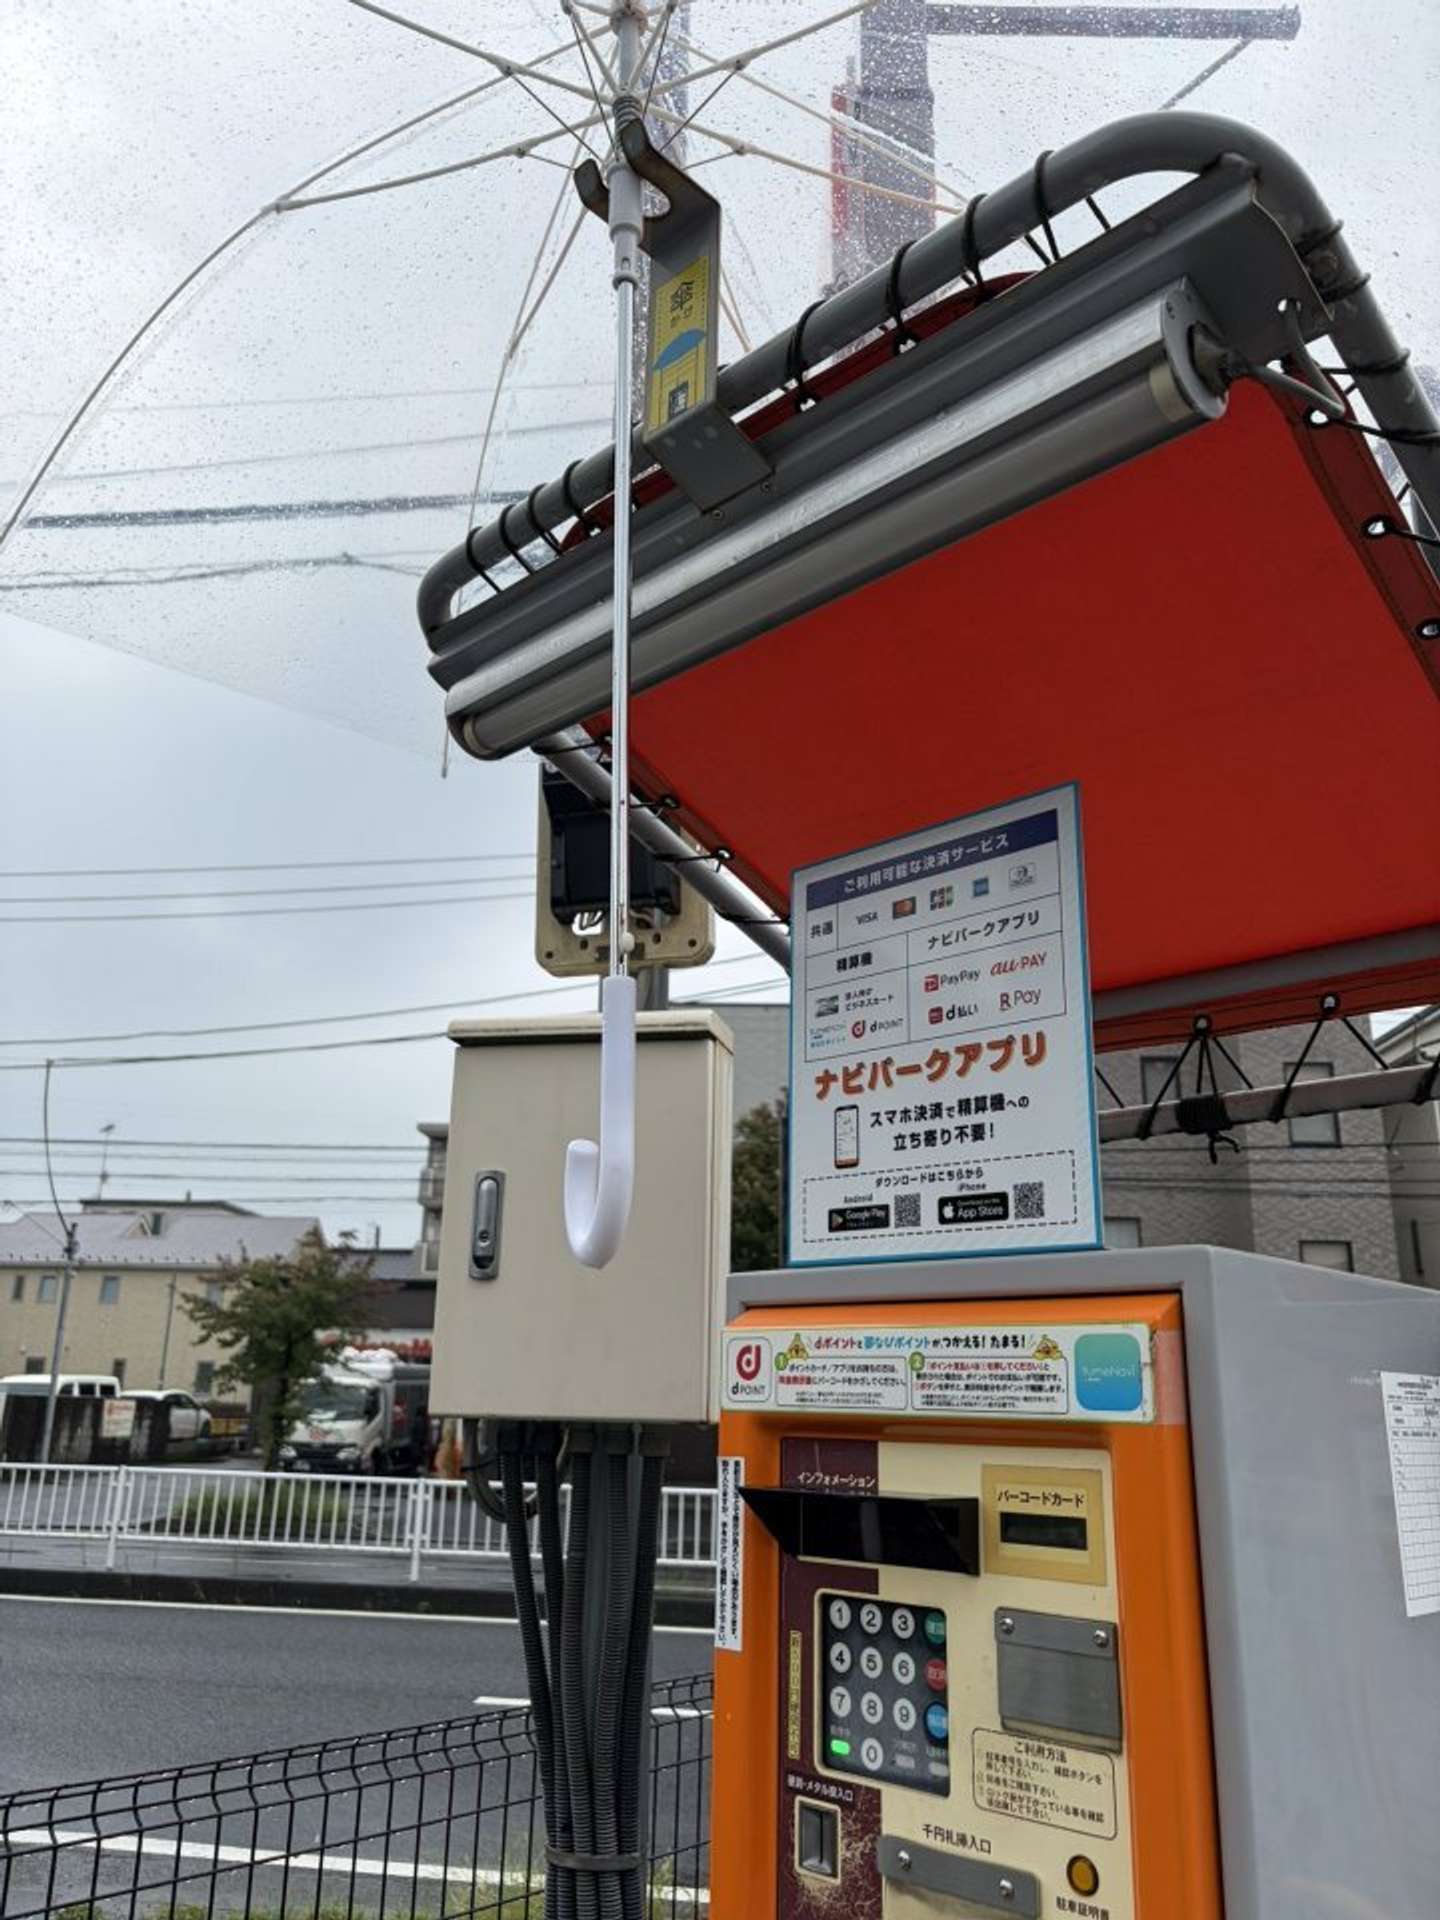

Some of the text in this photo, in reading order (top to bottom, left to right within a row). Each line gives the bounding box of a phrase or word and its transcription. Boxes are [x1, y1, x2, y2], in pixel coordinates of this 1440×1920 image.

[843, 833, 1009, 893] ご利用可能な決済サービス
[856, 911, 879, 926] VISA
[927, 910, 1041, 950] ナビパークアプリ
[836, 952, 873, 973] 精算機
[1020, 952, 1048, 970] PAY
[940, 969, 981, 986] PayPay
[1013, 989, 1042, 1006] Pay
[945, 1003, 979, 1021] d払い
[814, 1029, 1048, 1101] ナビパークアプリ
[870, 1093, 1030, 1128] スマホ決済で精算機への
[875, 1166, 985, 1188] ダウンロードはこちらから
[957, 1182, 987, 1193] iPhone
[843, 1193, 874, 1205] Android
[957, 1204, 1004, 1219] App Store
[797, 1471, 876, 1488] インフォメーション
[996, 1488, 1085, 1508] バーコードカード
[866, 1610, 877, 1627] 2
[898, 1614, 909, 1632] 3
[835, 1649, 845, 1666] 4
[866, 1654, 878, 1671] 5
[898, 1659, 910, 1677] 6
[835, 1693, 845, 1710] 7
[866, 1699, 878, 1717] 8
[898, 1705, 910, 1723] 9
[866, 1744, 877, 1763] 0
[1013, 1741, 1068, 1764] ご利用方法
[921, 1823, 992, 1854] 千円札挿入口
